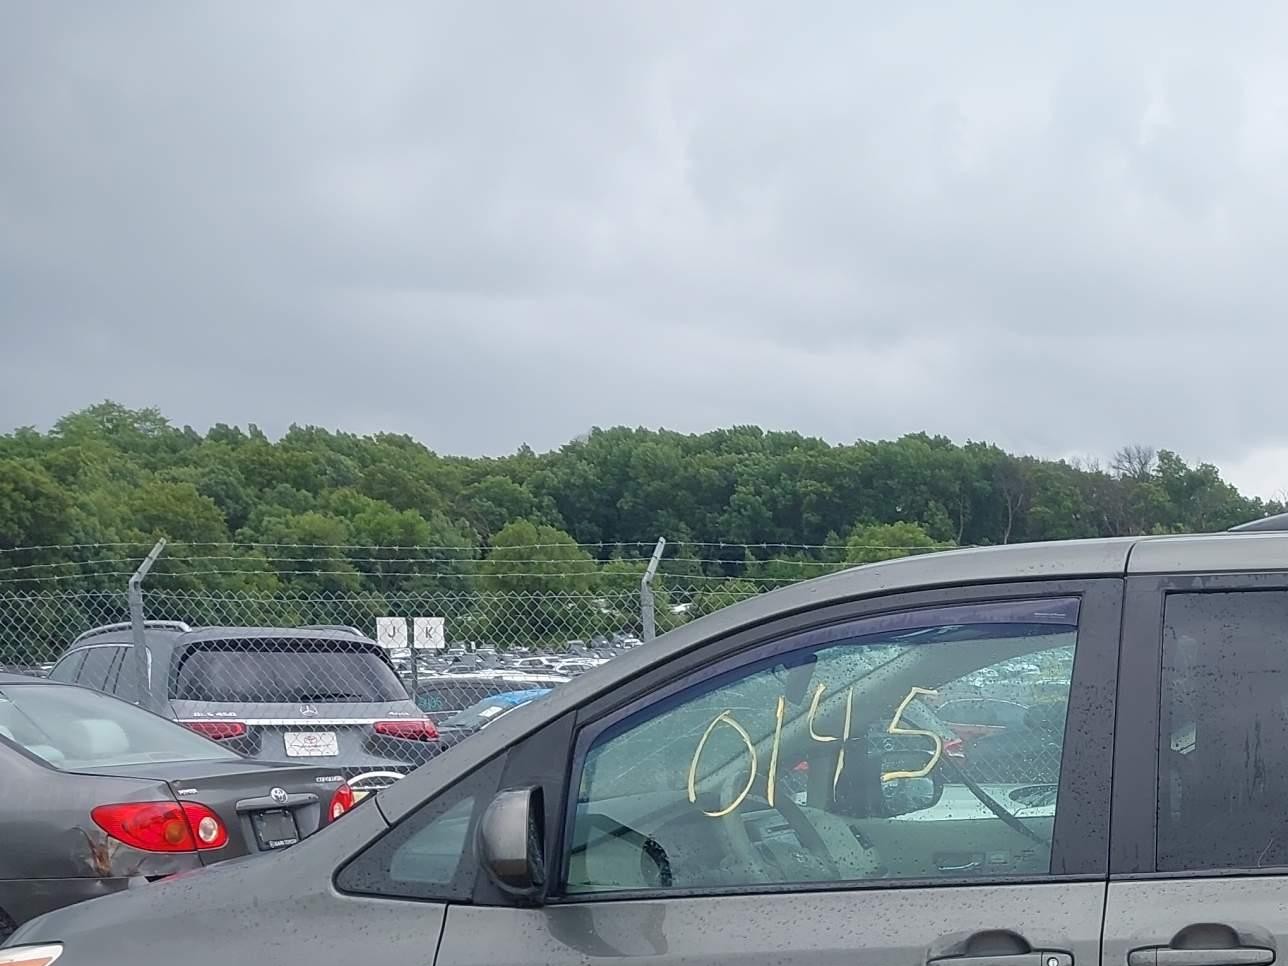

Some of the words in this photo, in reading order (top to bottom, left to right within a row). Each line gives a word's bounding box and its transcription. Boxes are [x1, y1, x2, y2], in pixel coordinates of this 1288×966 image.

[387, 626, 396, 638] J
[425, 626, 433, 639] K
[688, 683, 942, 817] 0145
